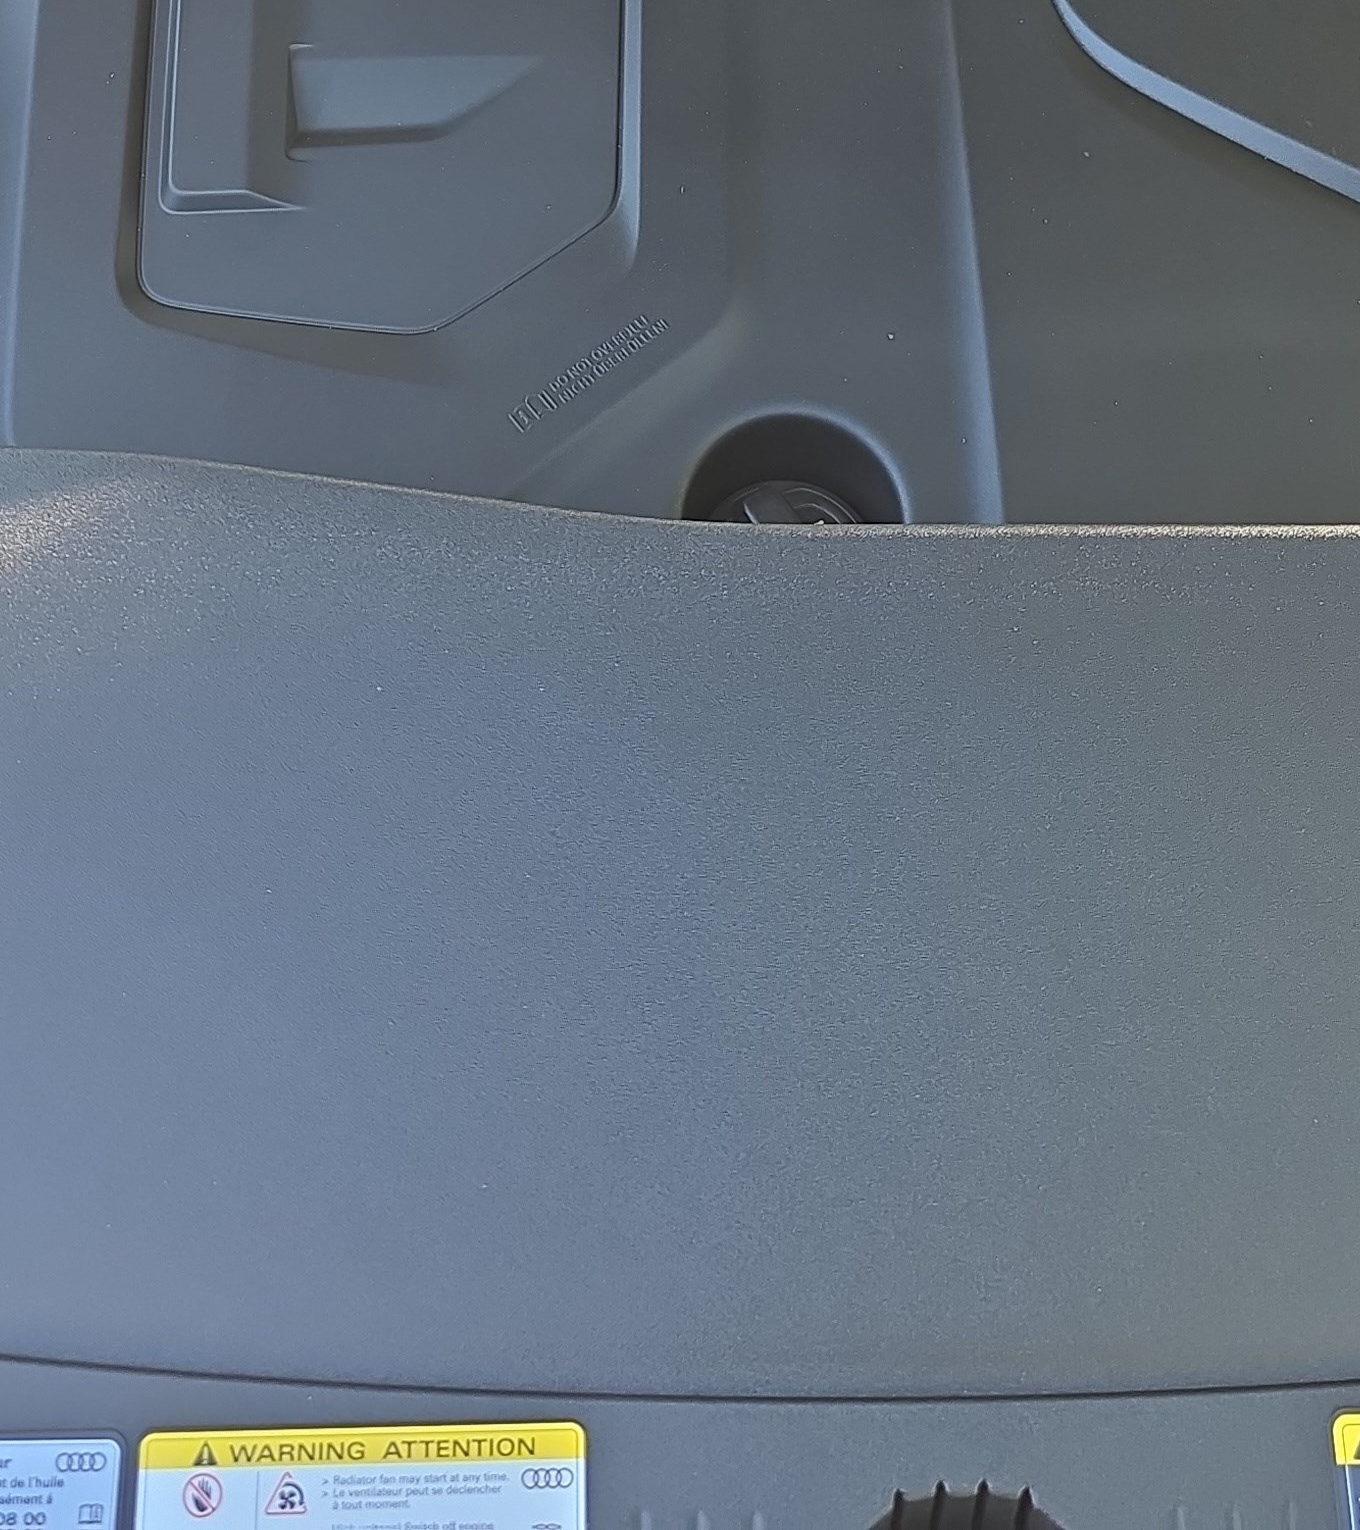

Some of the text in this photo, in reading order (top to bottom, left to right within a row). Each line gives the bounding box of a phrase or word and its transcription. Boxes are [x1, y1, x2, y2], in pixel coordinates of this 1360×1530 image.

[229, 1437, 536, 1463] WARNING ATTENTION
[9, 1476, 26, 1488] de
[23, 1511, 47, 1526] 00
